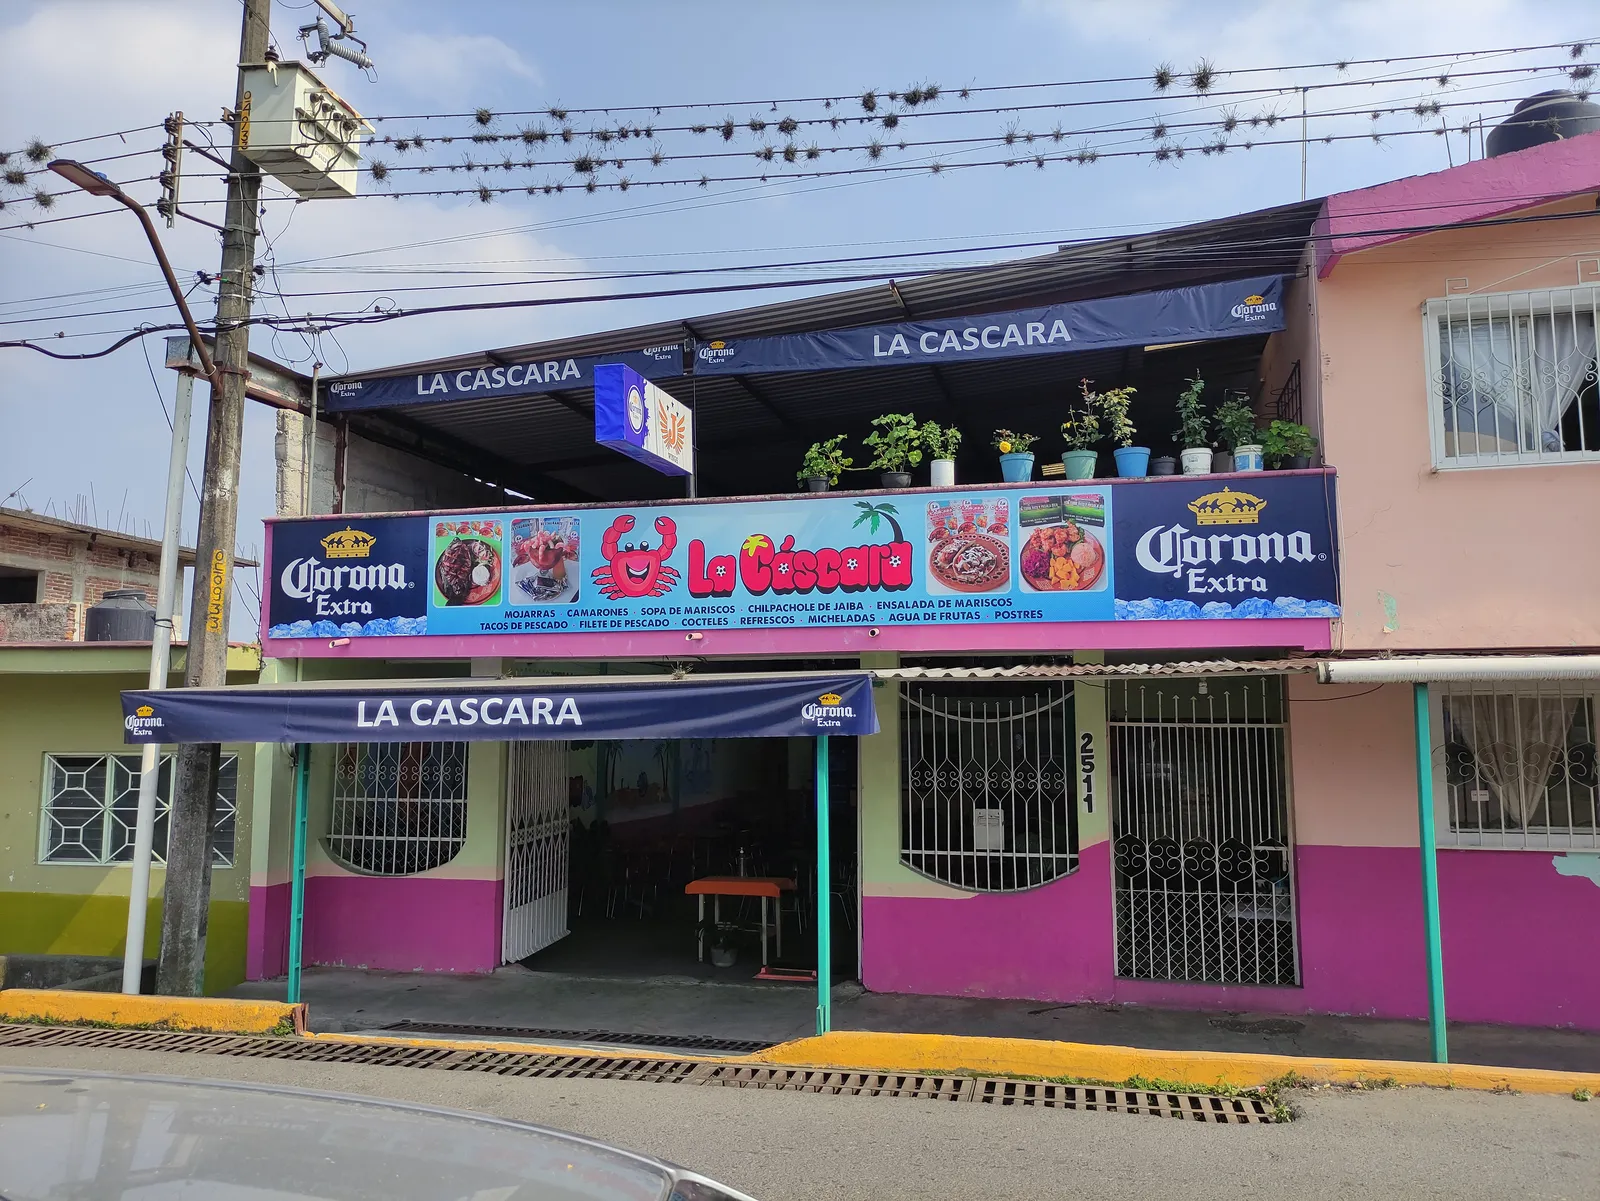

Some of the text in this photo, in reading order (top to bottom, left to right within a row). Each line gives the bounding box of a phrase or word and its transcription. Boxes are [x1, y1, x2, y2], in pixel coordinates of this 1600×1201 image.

[1231, 302, 1277, 318] Corona
[1244, 314, 1266, 322] Extra
[872, 318, 1072, 357] LA CASCARA
[699, 347, 735, 360] Corona
[417, 358, 581, 395] LA CASCARA
[330, 381, 363, 394] Corona
[1135, 523, 1316, 579] Corona
[687, 533, 913, 598] La Cáscara
[280, 555, 408, 603] Corona
[1186, 567, 1269, 594] Extra
[315, 593, 373, 616] Extra
[504, 598, 1013, 619] MOJARRAS CAMARONES SOPA DE MARISCOS CHILPACHOLE DE JAIBA ENSALADA DE MARISCOS
[480, 610, 1043, 631] TACOS DE PESCADO FILETE DE PESCADO COCTELES REFRESCOS MICHELADAS AGUA DE FRUTAS POSTRES
[357, 697, 583, 728] LA CASCARA
[801, 703, 854, 721] Corona
[817, 718, 841, 727] Extra
[125, 715, 163, 731] Corona
[133, 727, 153, 736] Extra
[1080, 732, 1095, 813] 2511
